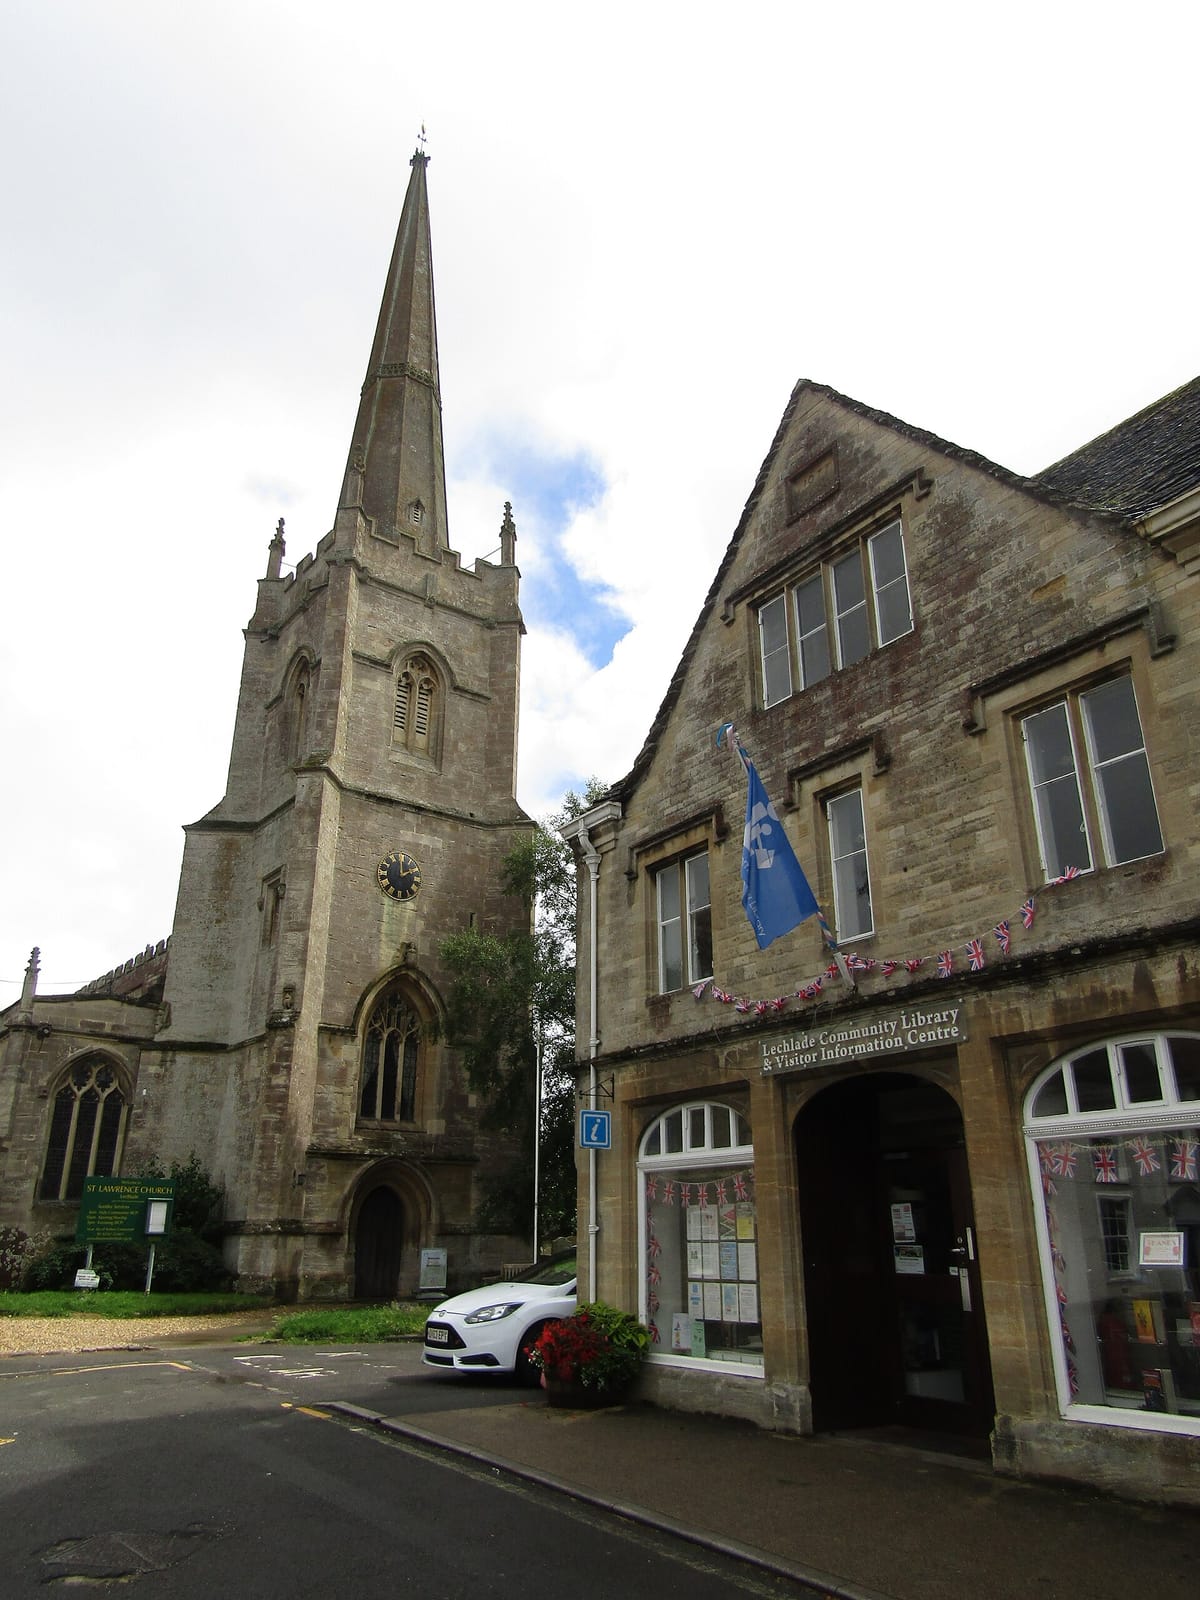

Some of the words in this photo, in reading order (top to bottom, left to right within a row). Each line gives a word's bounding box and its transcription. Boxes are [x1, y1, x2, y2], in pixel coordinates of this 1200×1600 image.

[763, 1034, 815, 1056] Lechlade
[819, 1020, 898, 1044] Community
[901, 1009, 959, 1029] Library
[763, 1058, 772, 1071] &
[775, 1052, 817, 1068] Visitor
[821, 1038, 903, 1061] Information
[907, 1026, 959, 1045] Centre
[98, 1185, 138, 1194] LAWRENCE
[140, 1185, 173, 1194] CHURCH
